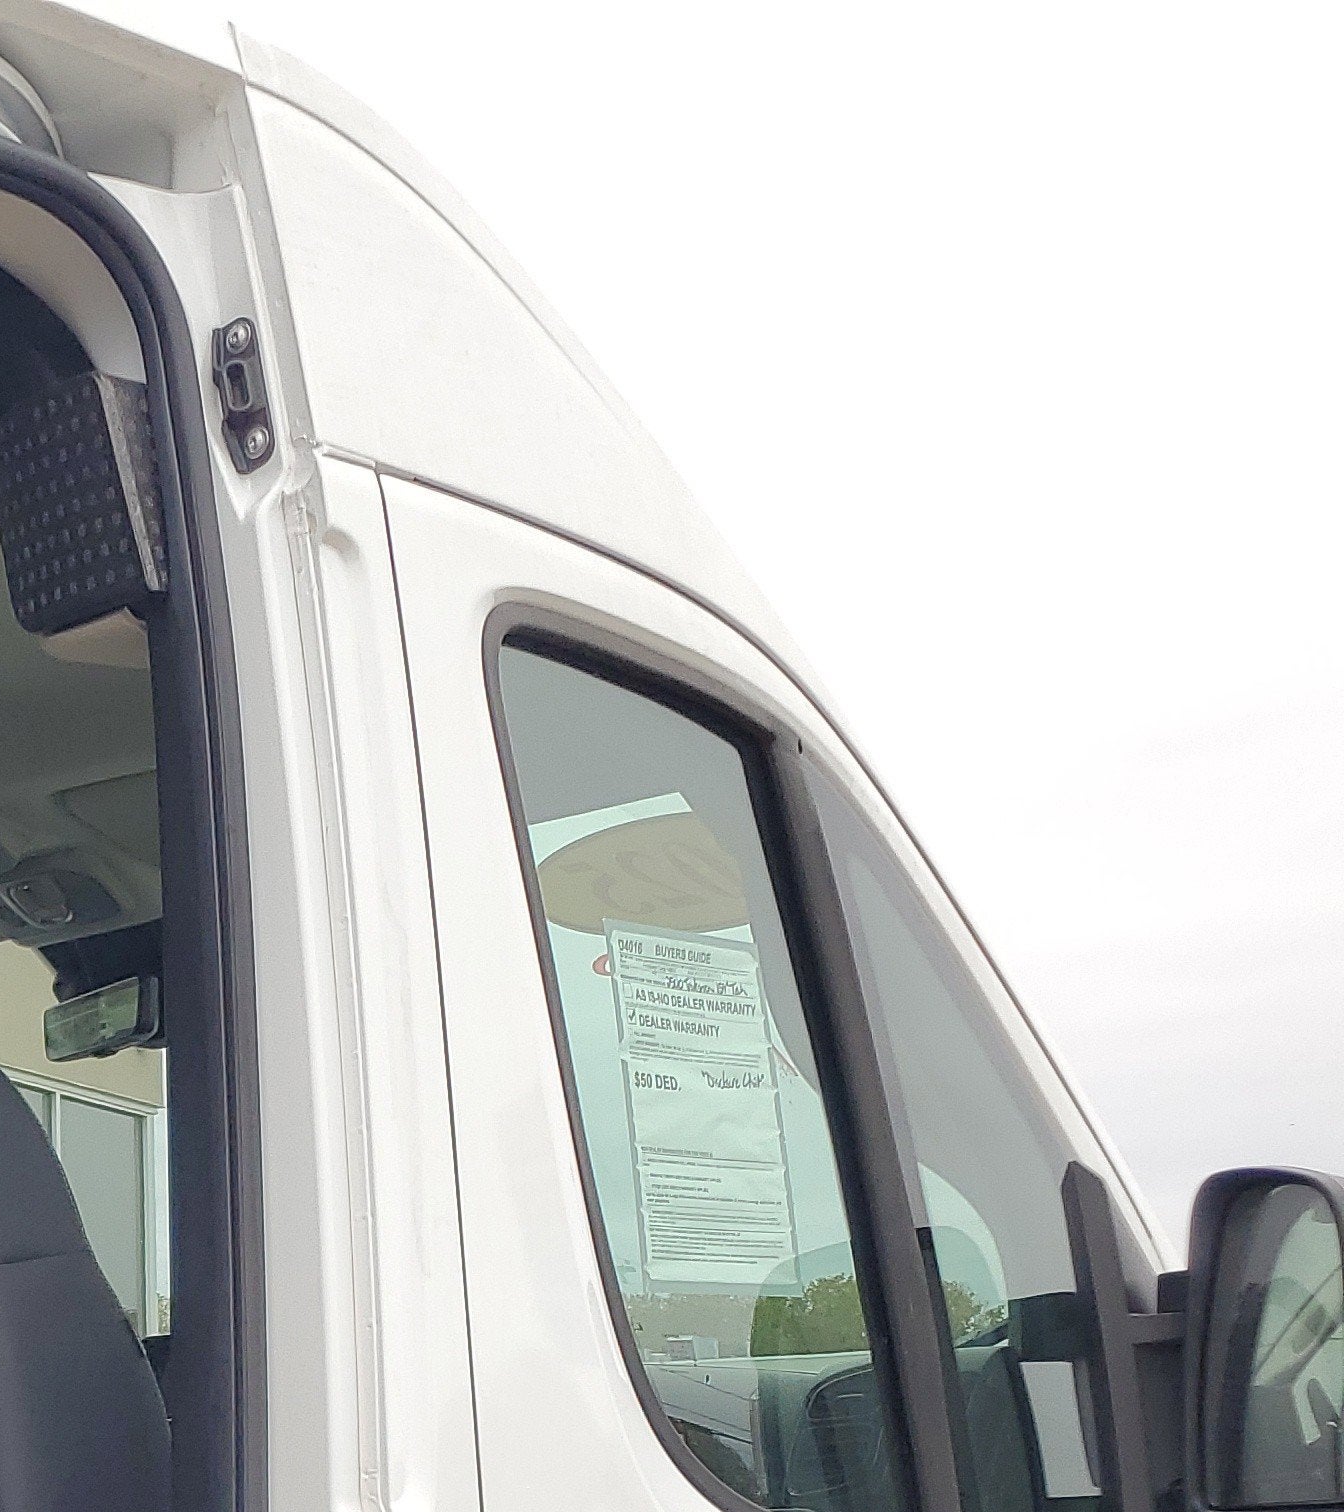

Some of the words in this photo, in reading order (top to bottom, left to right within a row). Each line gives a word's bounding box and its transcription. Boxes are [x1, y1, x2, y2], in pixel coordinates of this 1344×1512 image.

[655, 944, 686, 961] BUYERS
[687, 950, 712, 965] GUIDE
[635, 988, 647, 1002] AS
[671, 995, 705, 1011] DEALER
[705, 1001, 756, 1017] WARRANTY
[638, 1014, 673, 1032] DEALER
[673, 1020, 720, 1038] WARRANTY
[634, 1071, 653, 1089] $50
